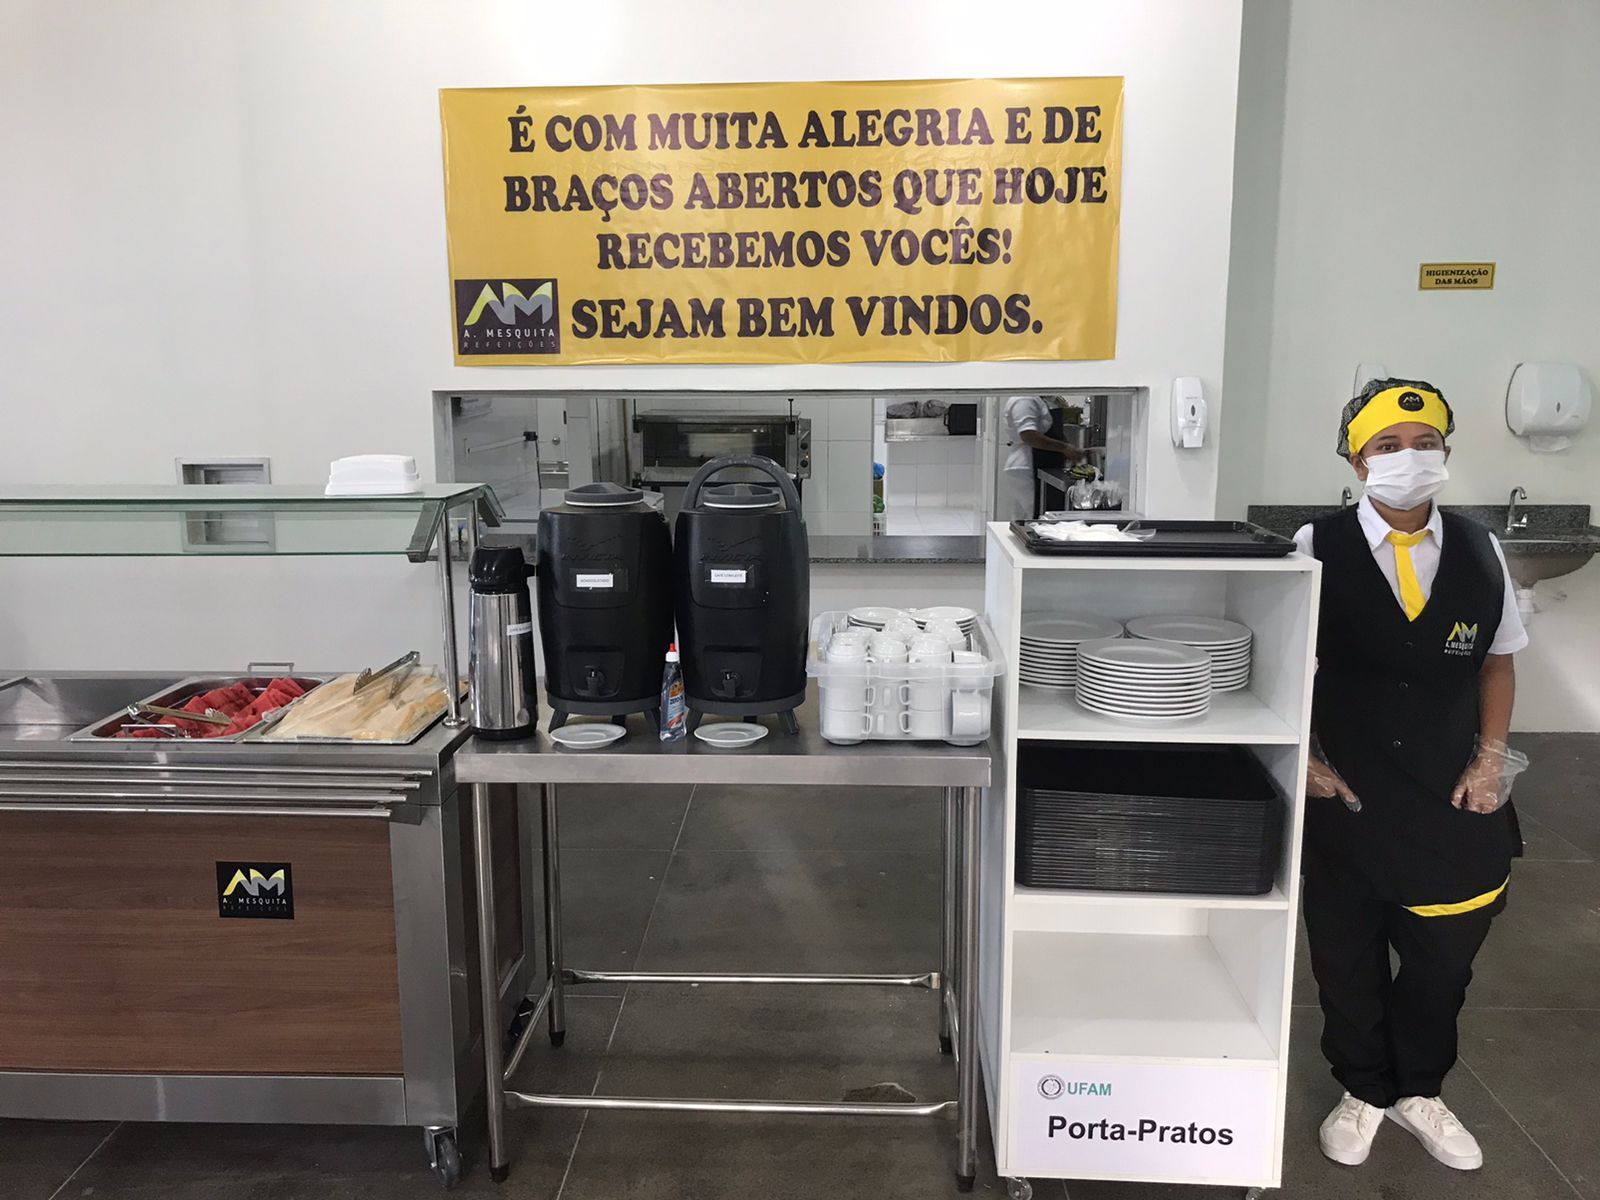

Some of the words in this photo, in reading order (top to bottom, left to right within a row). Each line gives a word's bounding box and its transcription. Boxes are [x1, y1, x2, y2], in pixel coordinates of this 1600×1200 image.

[508, 105, 535, 152] É
[545, 113, 637, 152] COM
[647, 111, 788, 150] MUITA
[798, 107, 994, 147] ALEGRIA
[1005, 106, 1032, 144] E
[1042, 106, 1102, 143] DE
[503, 173, 674, 222] BRAÇOS
[684, 170, 882, 209] ABERTOS
[893, 167, 983, 215] QUE
[993, 166, 1108, 204] HOJE
[597, 230, 850, 270] RECEBEMOS
[861, 217, 1012, 266] VOCÊS!
[1425, 268, 1489, 277] HIGIENIZAÇÃO
[1454, 277, 1478, 285] MÃOS
[571, 297, 726, 339] SEJAM
[737, 296, 835, 338] BEM
[845, 294, 1043, 337] VINDOS.
[463, 328, 477, 338] A.
[486, 328, 555, 339] MESQUITA
[238, 897, 287, 905] MESQUITA
[1067, 1082, 1112, 1096] UFAM
[1048, 1115, 1234, 1145] Porta-Pratos
